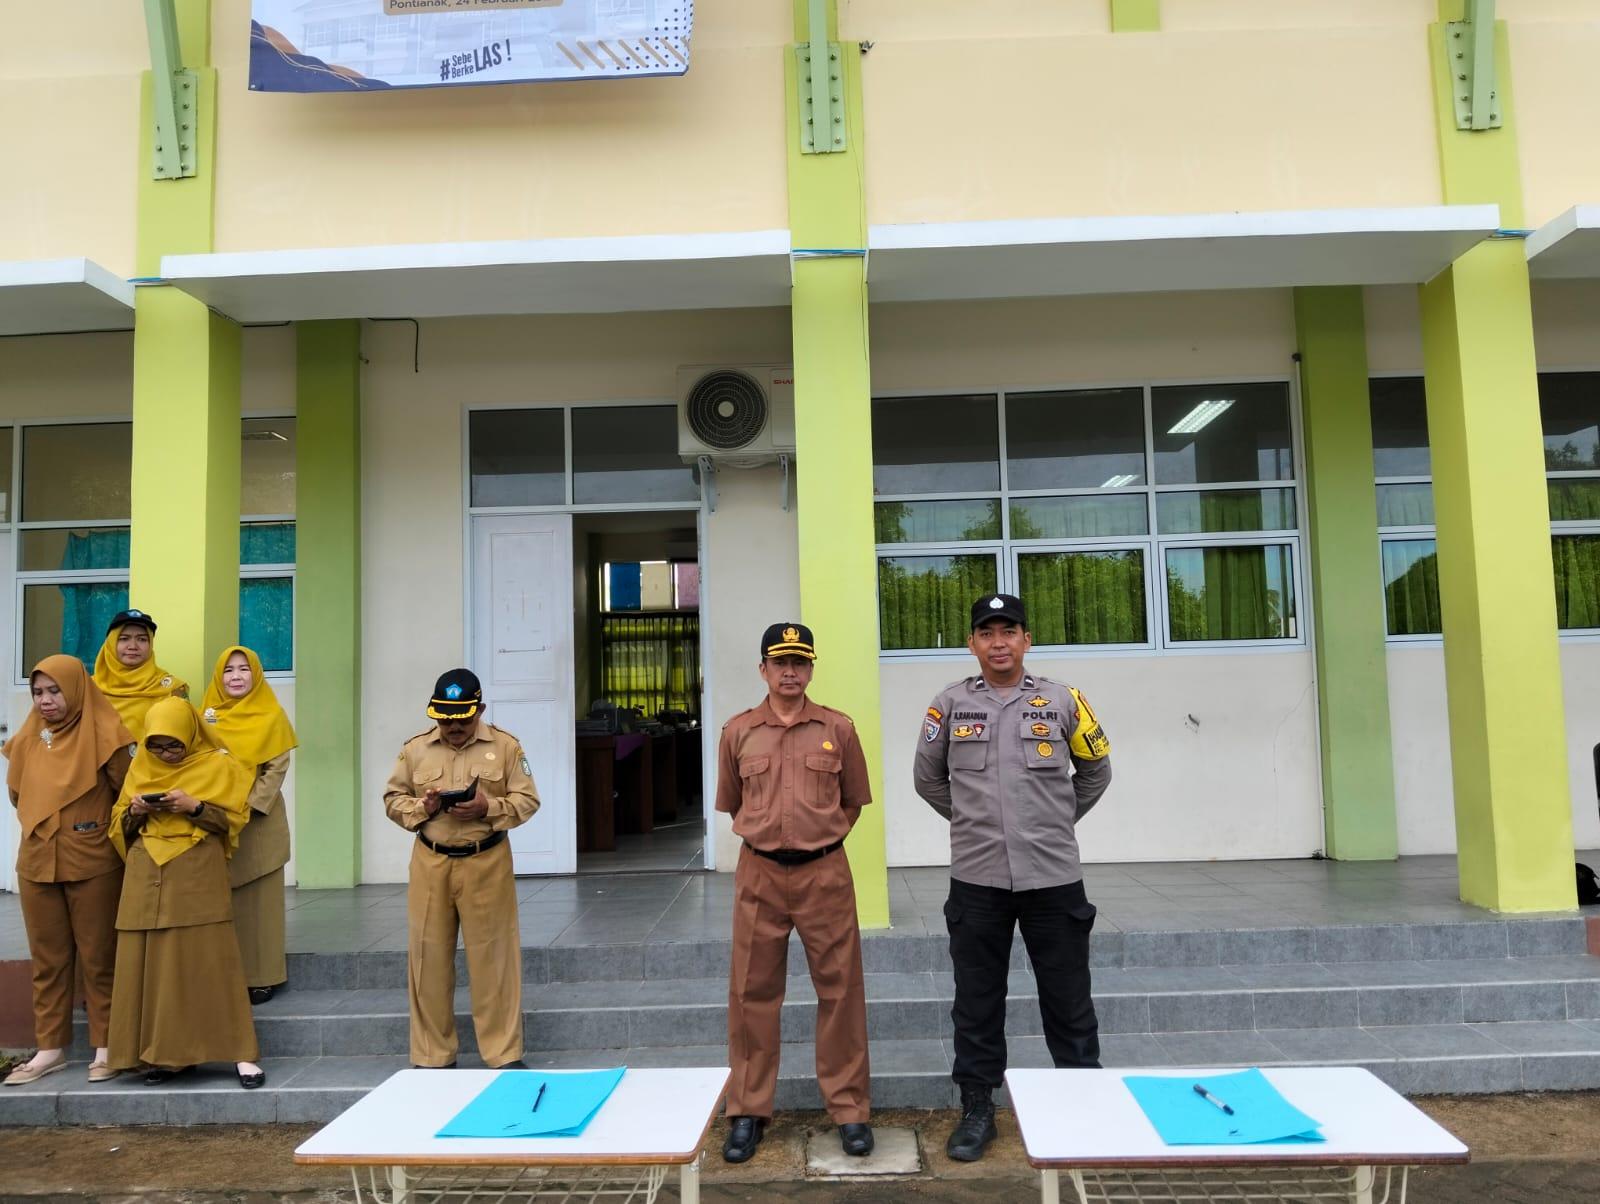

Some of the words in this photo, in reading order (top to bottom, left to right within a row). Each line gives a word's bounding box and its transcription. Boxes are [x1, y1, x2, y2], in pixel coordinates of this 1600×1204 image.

[452, 53, 472, 66] Sebe
[451, 64, 474, 78] Berke
[1022, 711, 1058, 720] POLRI
